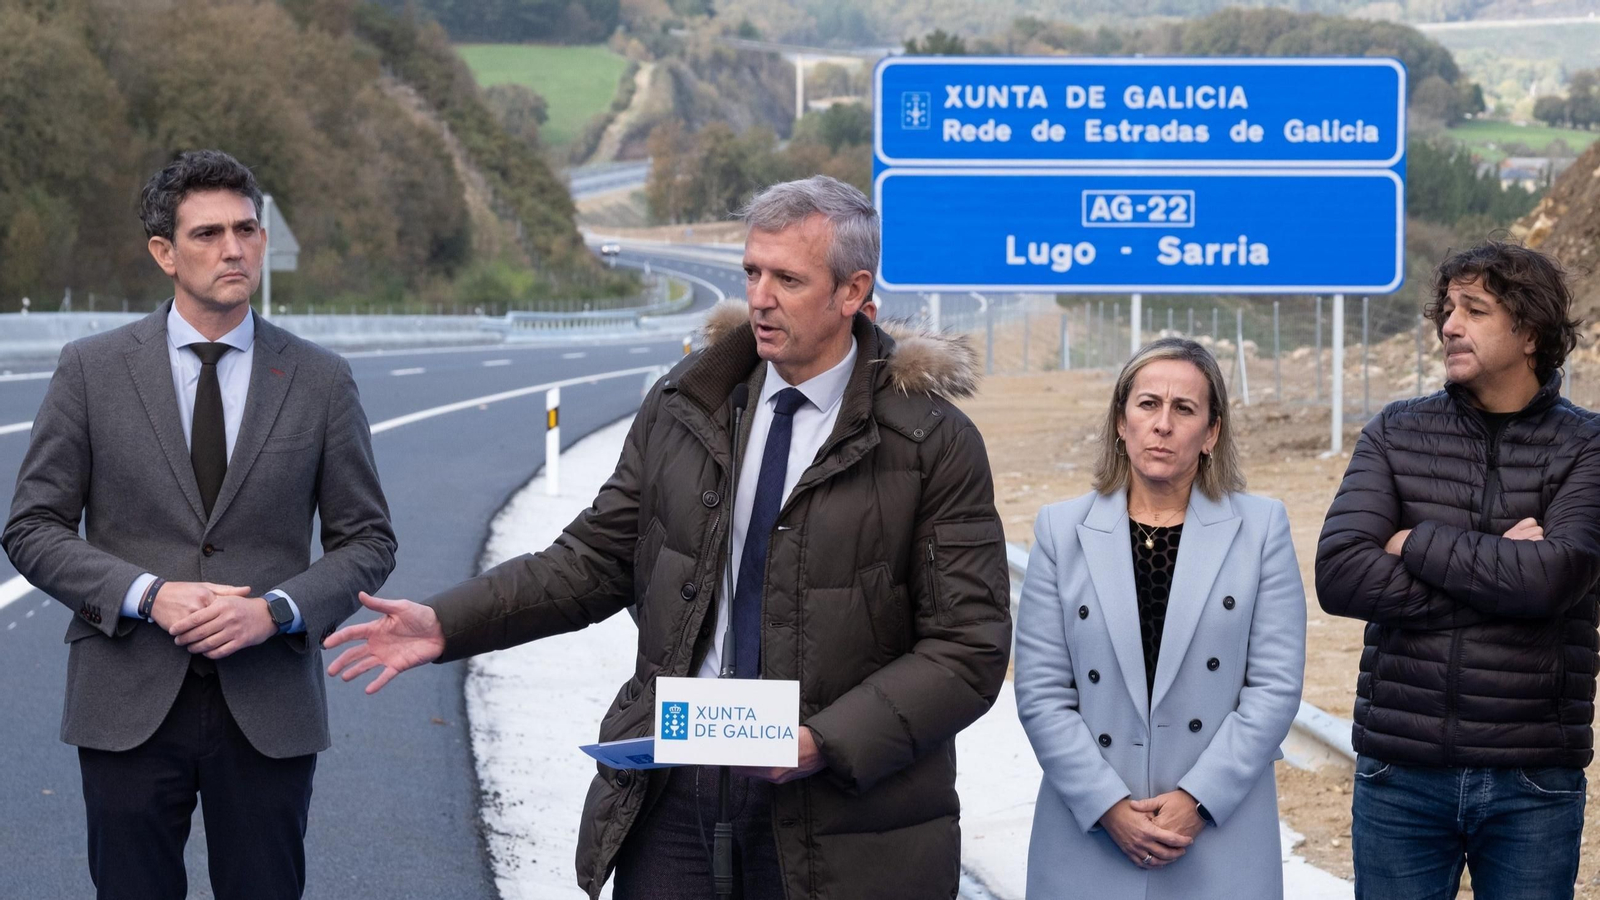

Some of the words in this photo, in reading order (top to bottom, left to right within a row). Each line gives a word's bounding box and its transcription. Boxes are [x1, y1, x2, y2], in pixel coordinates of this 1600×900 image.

[944, 85, 1048, 109] XUNTA
[1066, 85, 1106, 109] DE
[1123, 85, 1249, 110] GALICIA
[943, 118, 1012, 142] Rede
[1031, 118, 1066, 142] de
[1085, 118, 1210, 143] Estradas
[1229, 119, 1265, 143] de
[1284, 118, 1379, 143] Galicia
[1090, 196, 1188, 222] AG-22
[1006, 235, 1097, 273] Lugo
[1120, 246, 1132, 255] -
[1157, 235, 1270, 266] Sarria
[696, 705, 757, 721] XUNTA
[695, 723, 717, 738] DE
[723, 723, 794, 740] GALICIA
